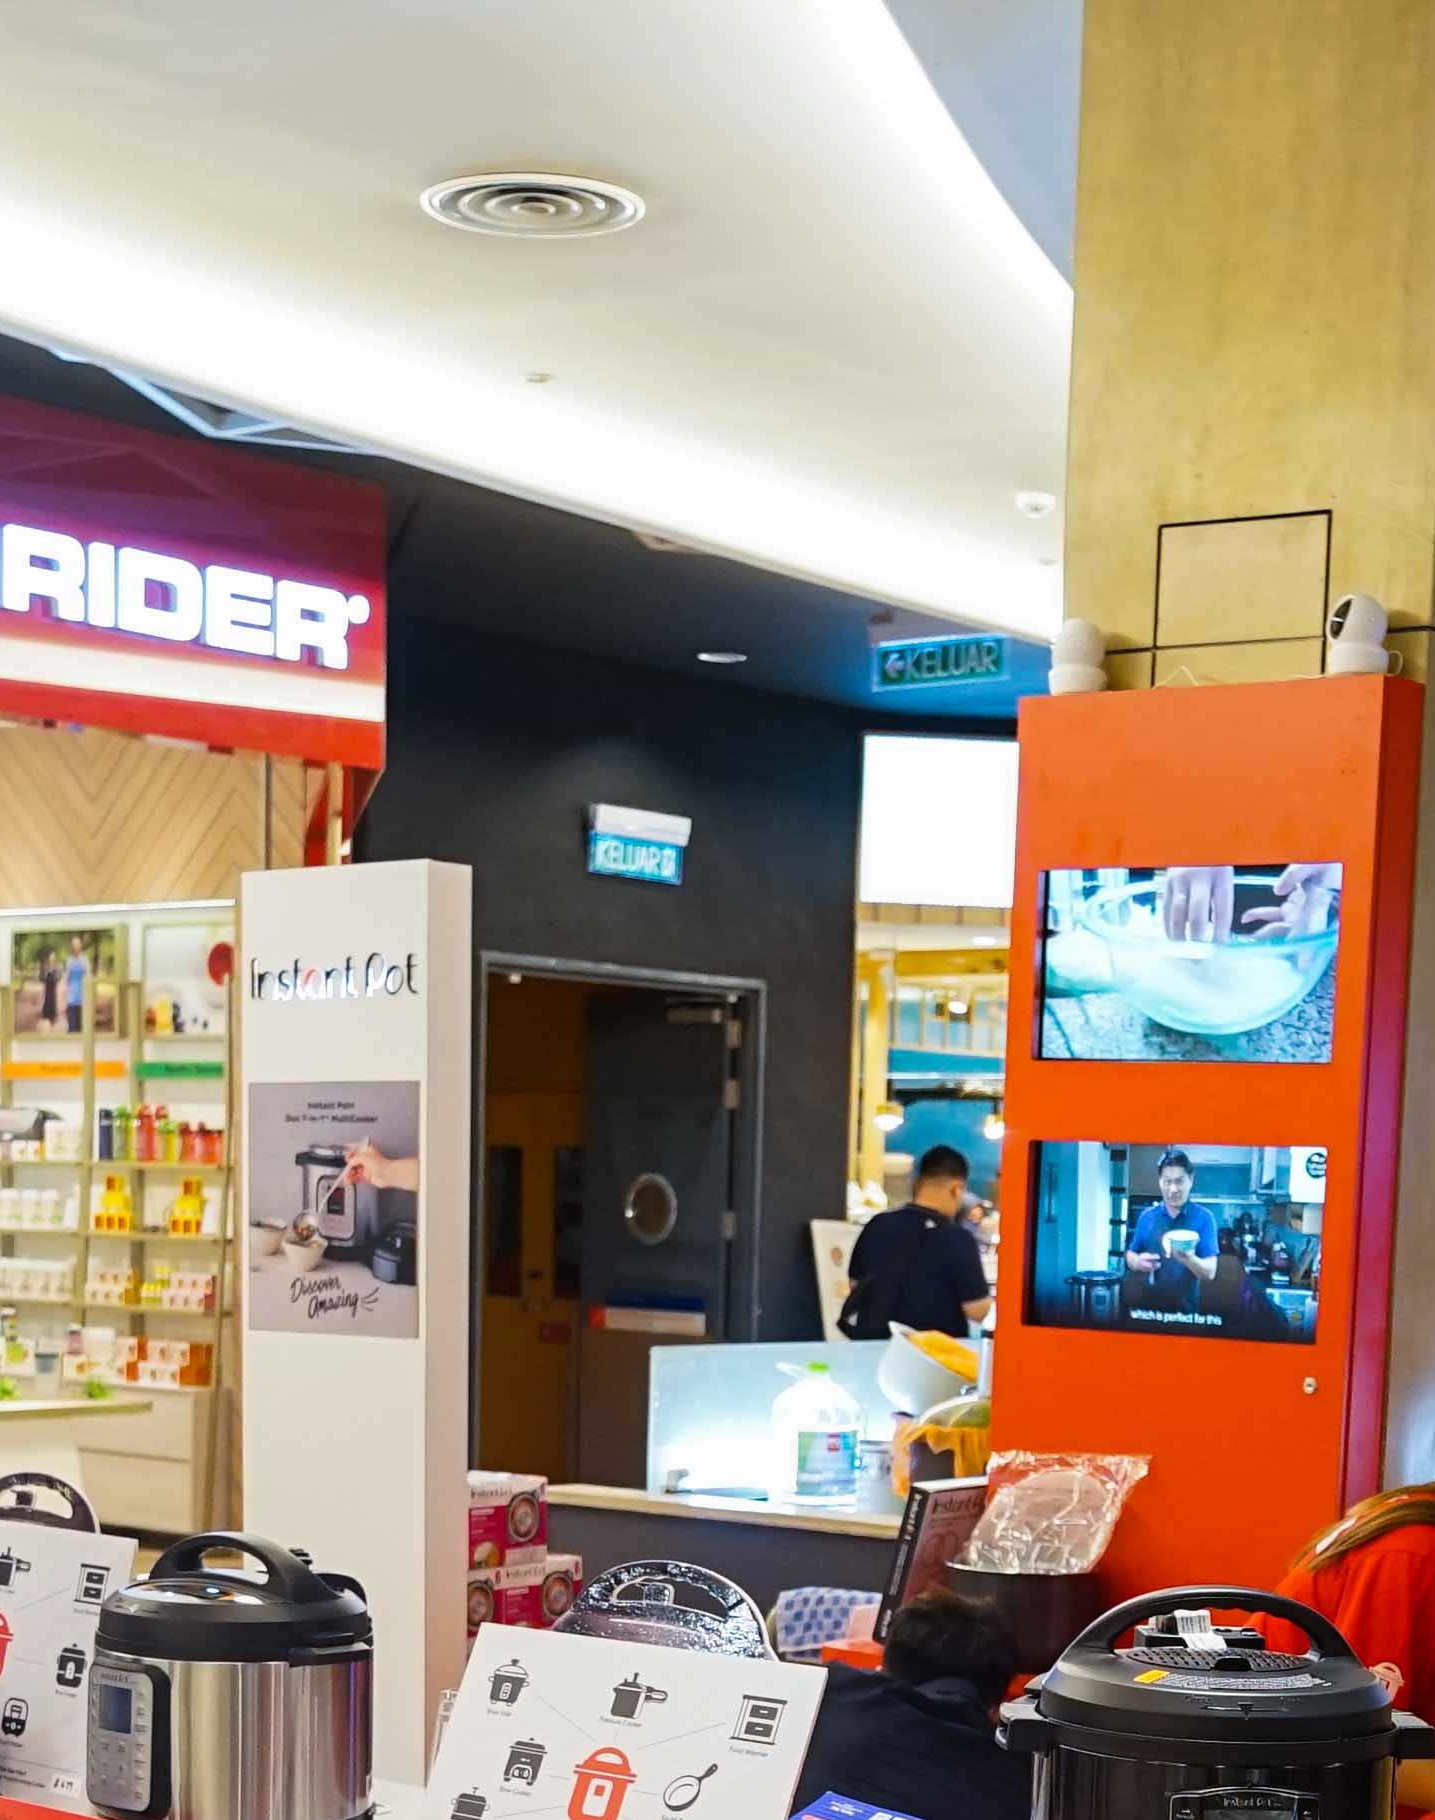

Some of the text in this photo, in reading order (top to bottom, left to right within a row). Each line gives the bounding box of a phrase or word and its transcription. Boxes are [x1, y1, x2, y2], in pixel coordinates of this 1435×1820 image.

[904, 641, 999, 681] KELUAR
[251, 952, 419, 1001] Instant Pot
